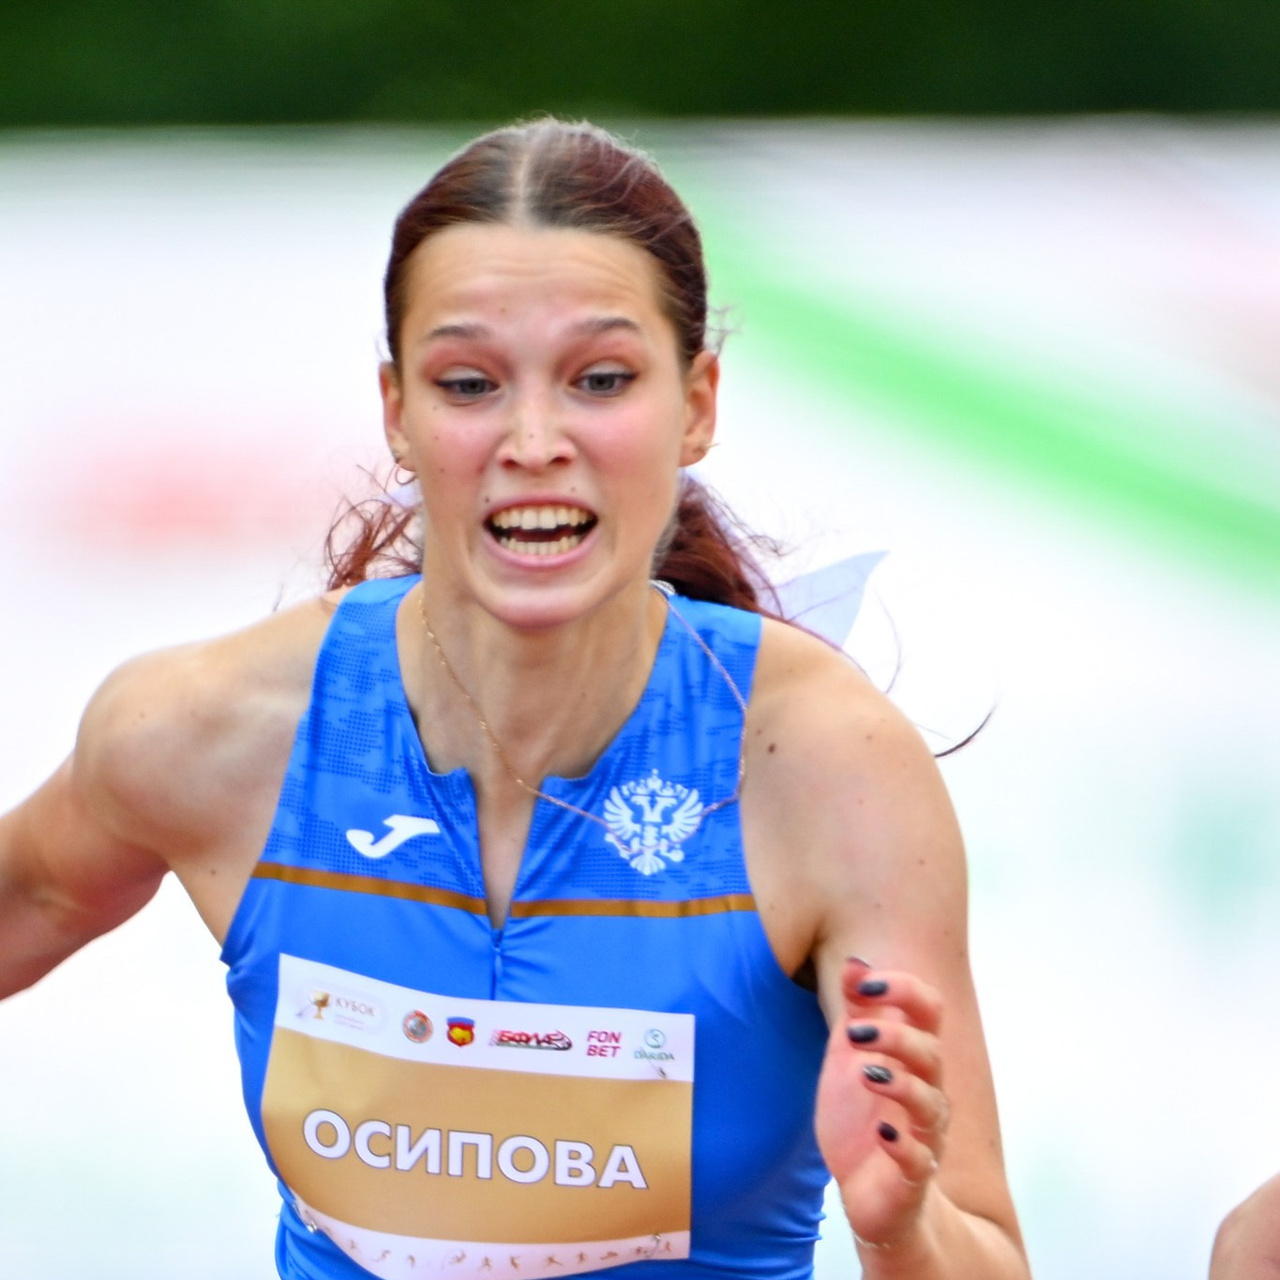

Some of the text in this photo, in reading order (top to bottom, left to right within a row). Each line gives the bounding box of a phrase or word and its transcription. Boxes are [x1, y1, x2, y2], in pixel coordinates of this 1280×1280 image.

[587, 1030, 622, 1044] FON
[586, 1044, 622, 1058] BET
[302, 1108, 649, 1190] ОСИПОВА
